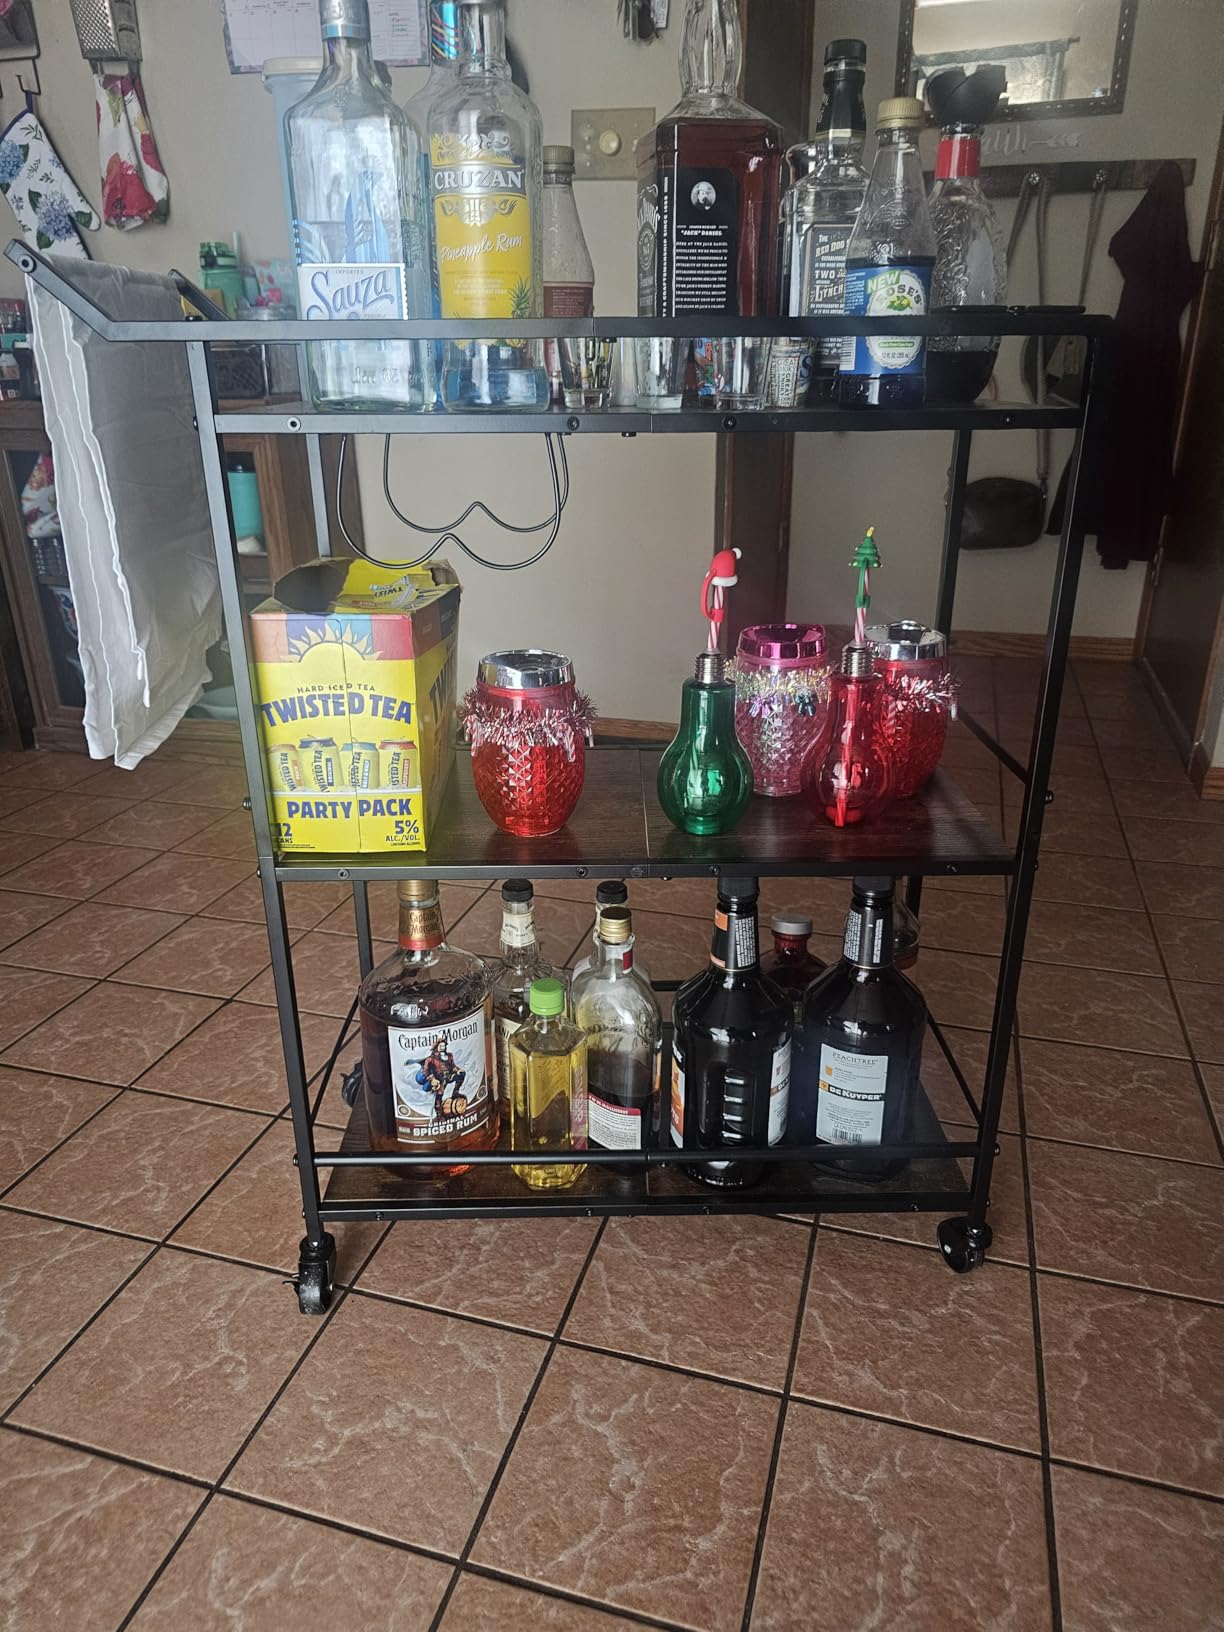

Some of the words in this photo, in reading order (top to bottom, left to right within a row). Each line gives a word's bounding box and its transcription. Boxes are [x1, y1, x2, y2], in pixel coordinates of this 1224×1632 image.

[434, 169, 522, 190] CRUZAN
[818, 235, 829, 243] THE
[440, 234, 494, 263] Pineapple
[496, 233, 522, 252] Rum
[815, 270, 835, 279] TWO
[867, 270, 900, 294] NEW
[305, 270, 395, 320] Sauza
[296, 684, 323, 694] HARD
[328, 682, 353, 692] ICED
[358, 683, 376, 692] TEA
[261, 692, 365, 727] TWISTED
[368, 693, 412, 725] TEA
[279, 752, 289, 765] TEA
[313, 749, 323, 764] TEA
[351, 751, 362, 765] TEA
[391, 752, 401, 765] TEA
[286, 801, 353, 819] PARTY
[358, 798, 412, 817] PACK
[275, 823, 293, 837] 12
[394, 820, 419, 834] 5%
[385, 834, 420, 842] ALC./VOL.
[409, 911, 439, 924] Captain
[398, 1031, 438, 1051] Captain
[438, 1021, 479, 1043] Morgan
[832, 1051, 876, 1065] PEACHTREE
[412, 1123, 454, 1137] SPICED
[456, 1113, 478, 1130] RUM
[428, 1115, 465, 1128] ORIGINAL
